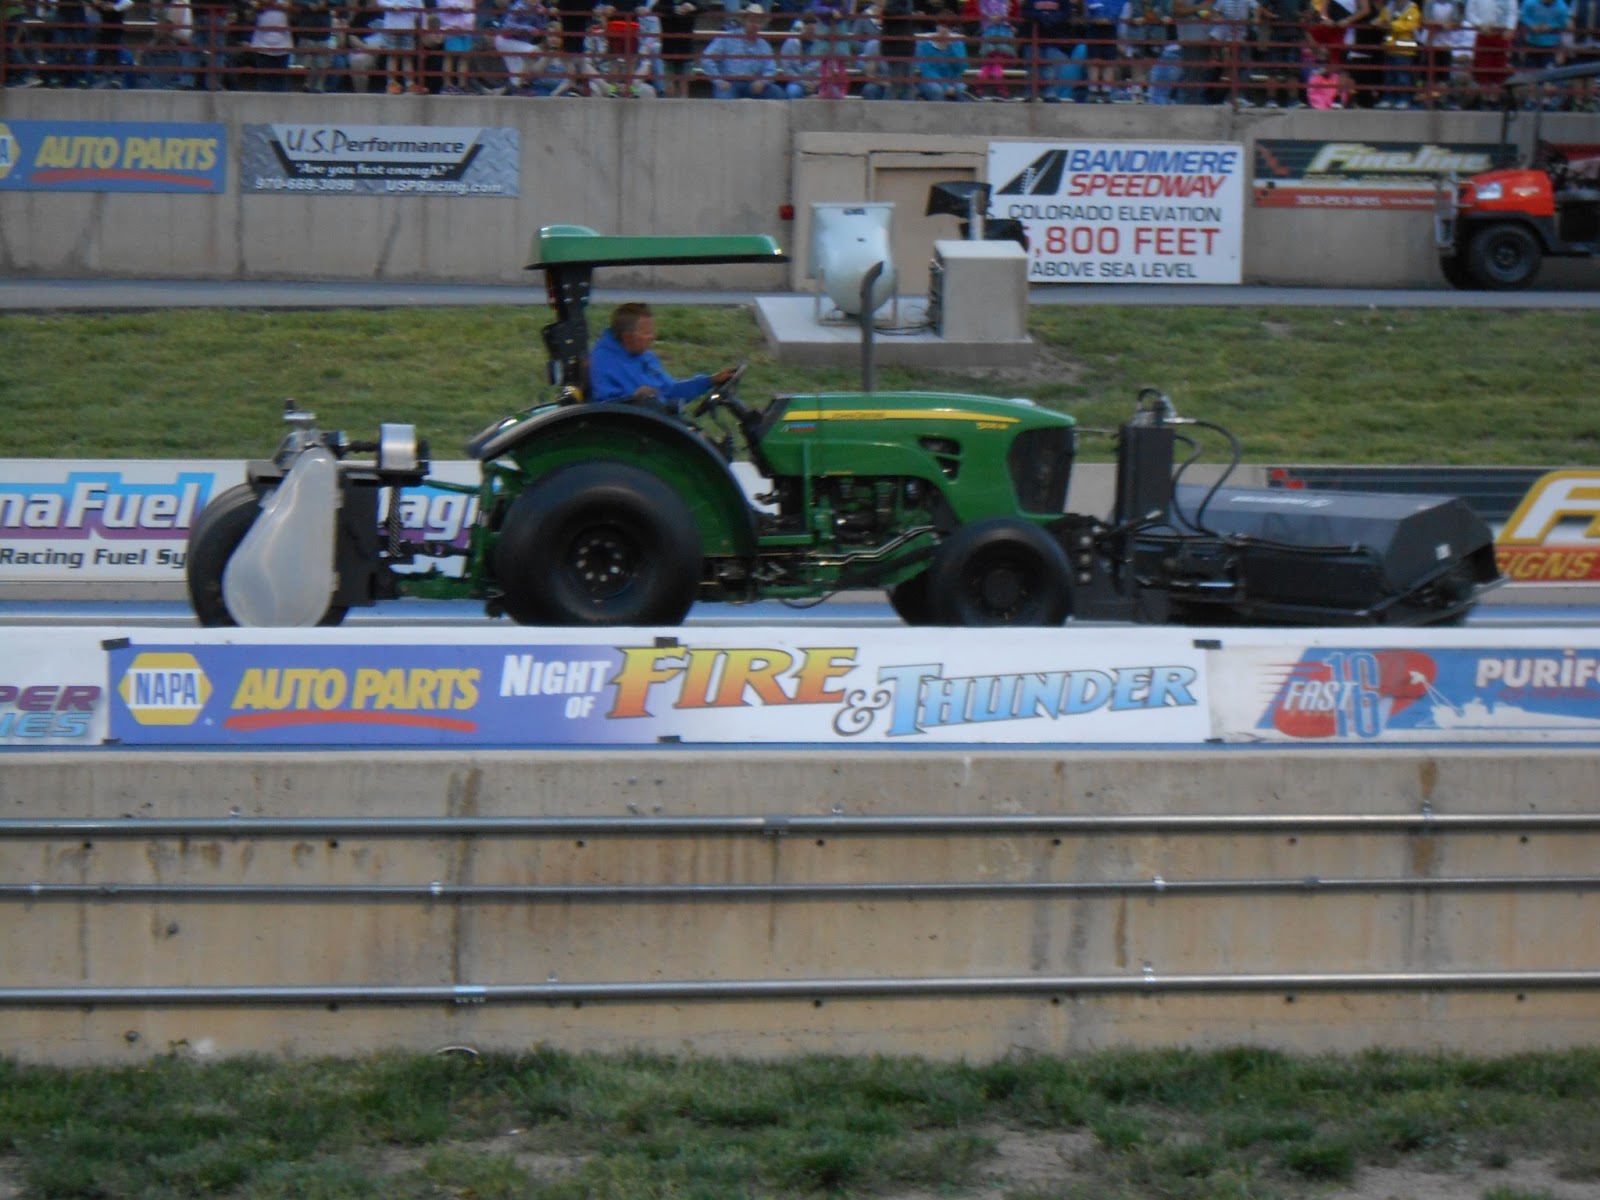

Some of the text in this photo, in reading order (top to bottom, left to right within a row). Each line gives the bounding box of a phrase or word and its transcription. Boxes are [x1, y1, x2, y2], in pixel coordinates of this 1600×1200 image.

[35, 136, 118, 168] AUTO
[123, 137, 217, 170] PARTS
[1069, 150, 1237, 173] BANDIMERE
[1068, 174, 1227, 197] SPEEDWAY
[1008, 204, 1221, 222] COLORADO ELEVATION
[1134, 228, 1220, 255] FEET
[1031, 262, 1197, 278] ABOVE SEA LEVEL
[0, 548, 83, 569] Racing
[94, 549, 146, 565] Fuel
[134, 672, 198, 705] NAPA
[231, 668, 481, 711] AUTO PARTS
[500, 654, 613, 697] NIGHT
[605, 645, 860, 719] FIRE
[565, 696, 595, 719] OF
[832, 663, 1197, 737] & THUNDER
[1283, 680, 1360, 712] FAST
